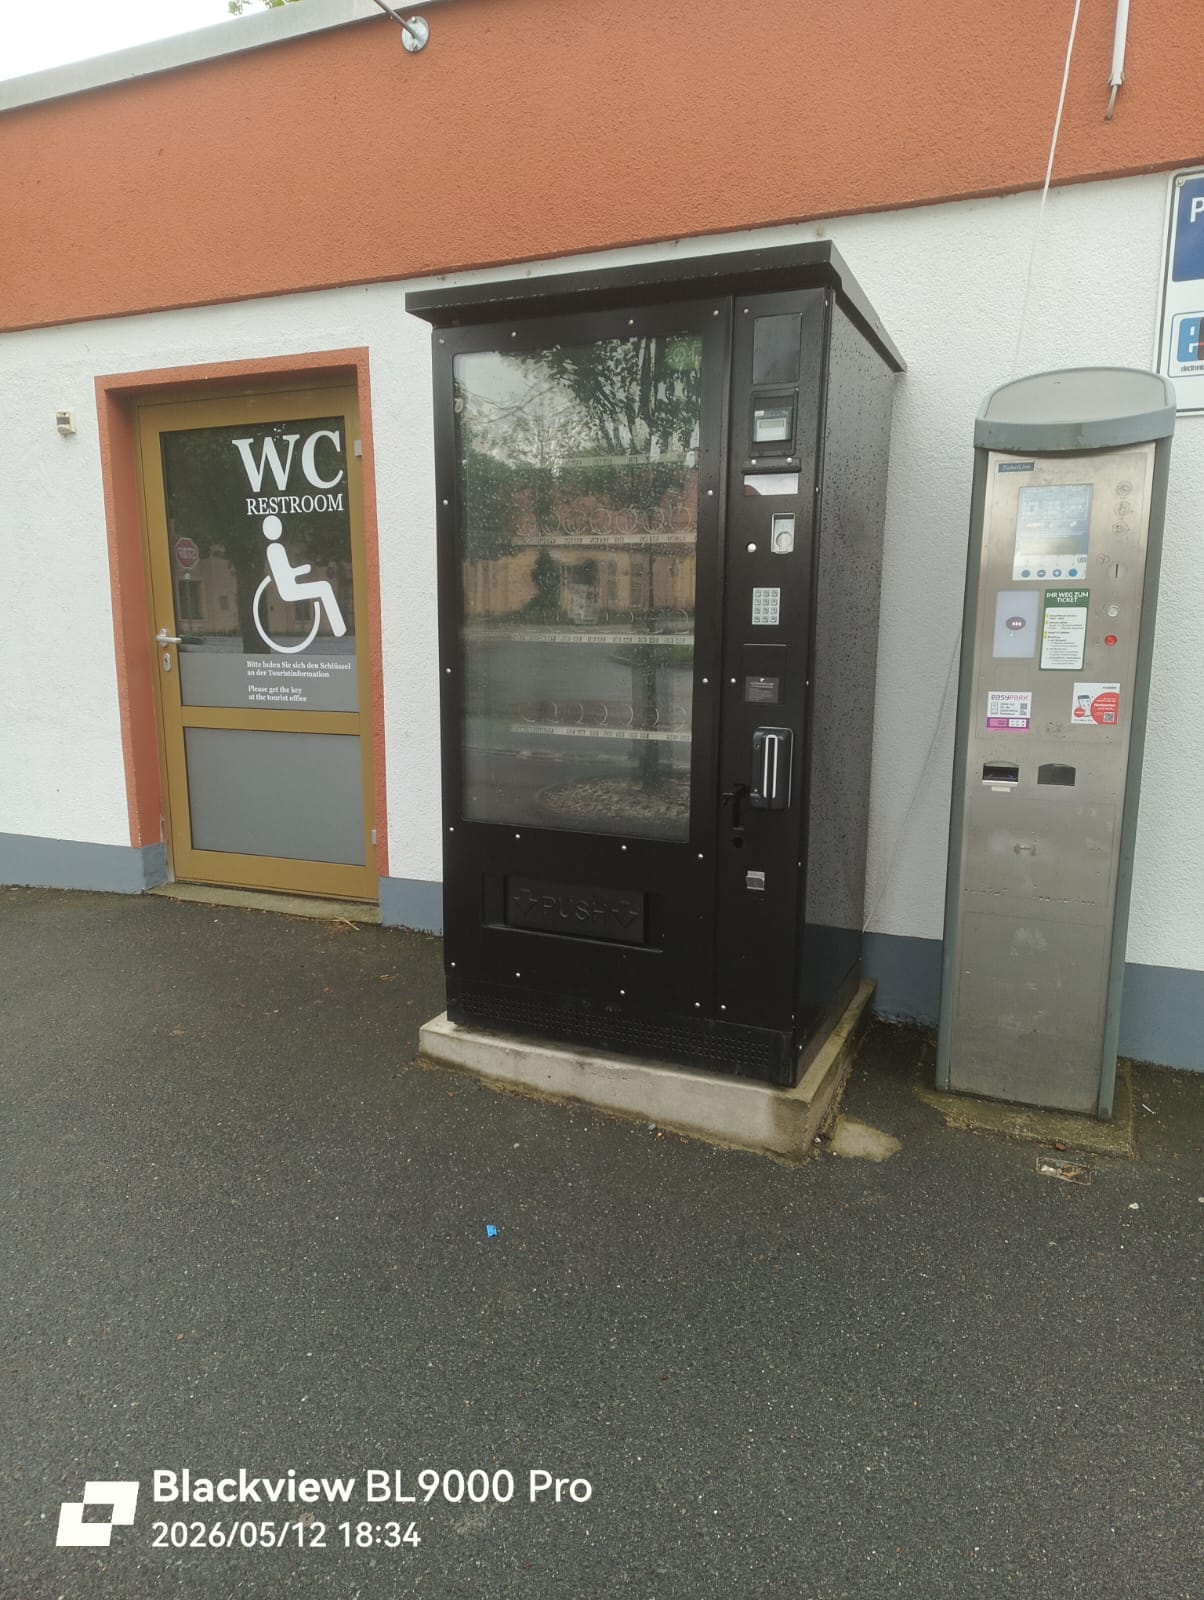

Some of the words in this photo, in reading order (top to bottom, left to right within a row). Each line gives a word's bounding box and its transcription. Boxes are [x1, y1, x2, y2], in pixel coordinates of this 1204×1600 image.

[232, 430, 344, 492] WC
[246, 494, 344, 515] RESTROOM
[247, 660, 261, 668] Bitte
[262, 661, 280, 669] holen
[281, 661, 291, 669] Sie
[292, 661, 305, 669] sich
[306, 661, 319, 669] den
[320, 662, 351, 670] Schlüssel
[268, 669, 330, 678] Touristinformation
[280, 685, 290, 693] the
[291, 686, 302, 695] key
[543, 895, 607, 926] PUSH
